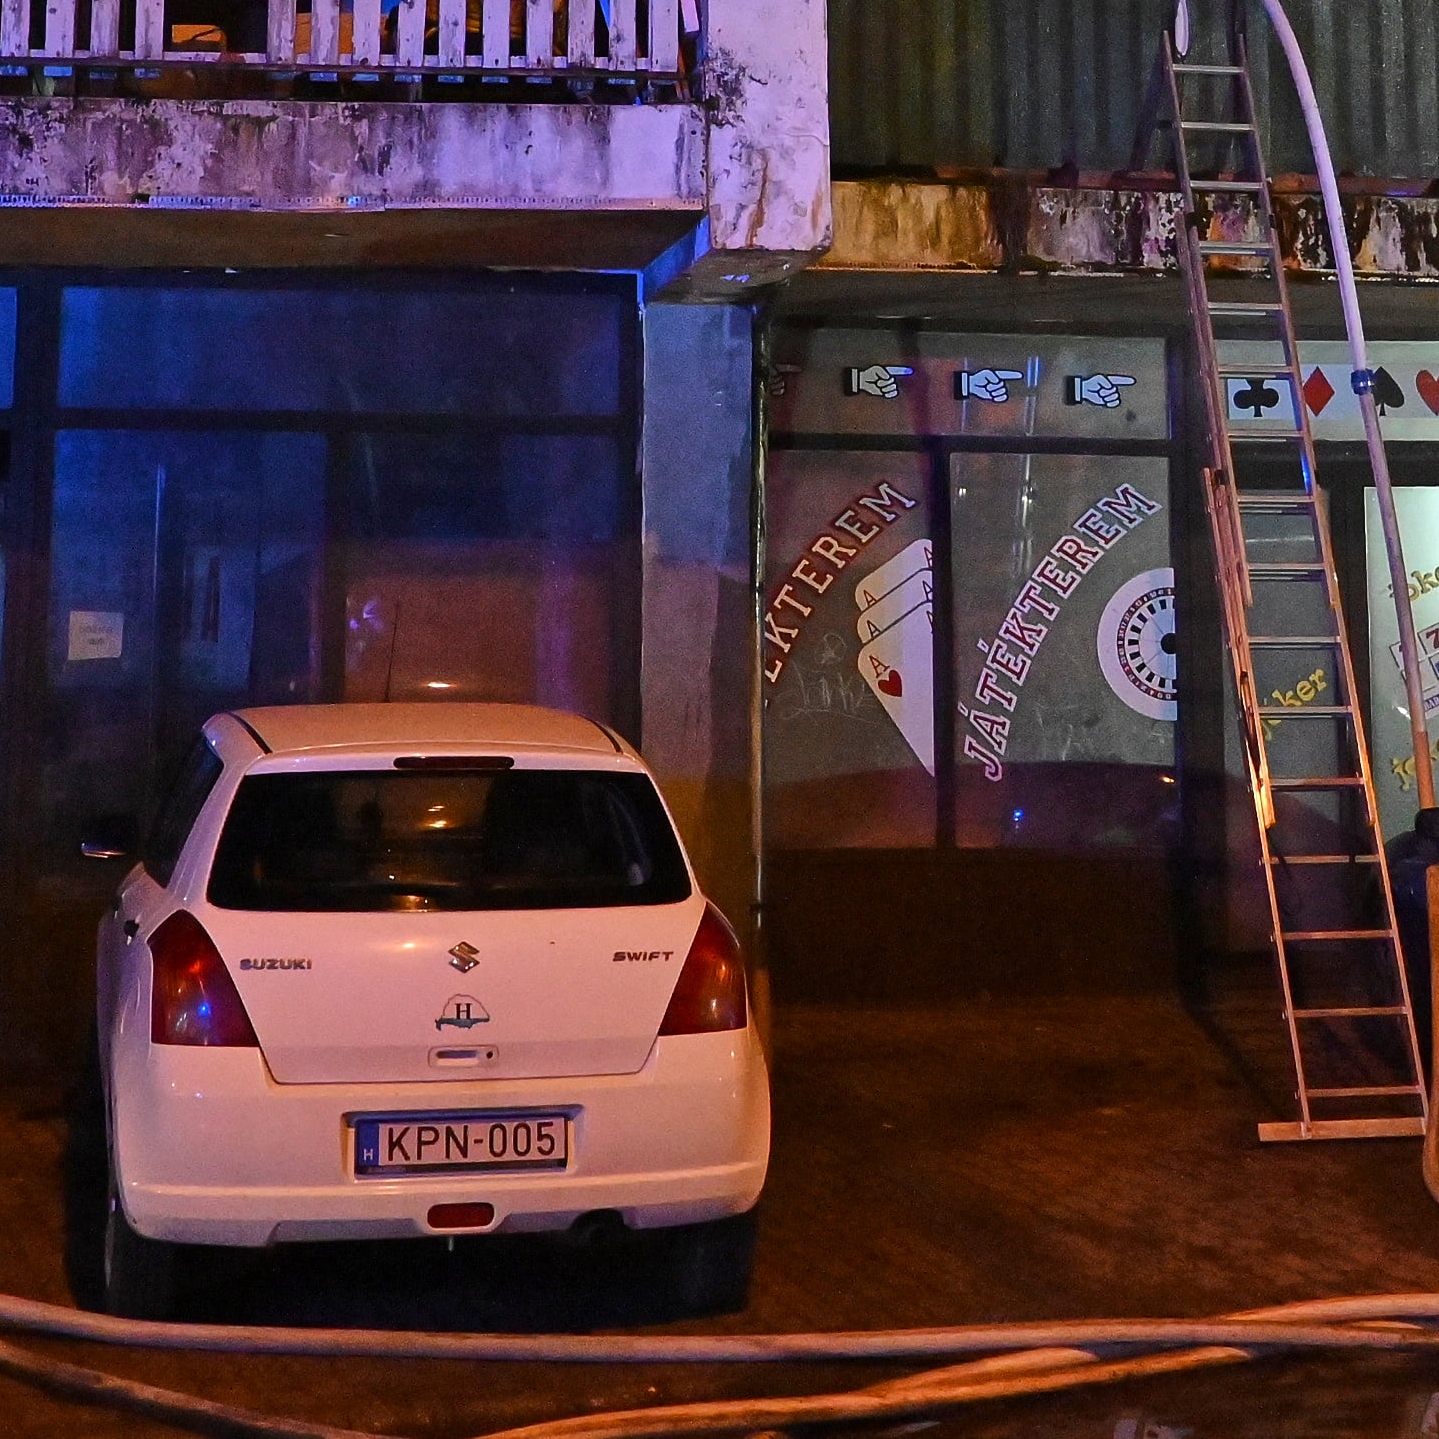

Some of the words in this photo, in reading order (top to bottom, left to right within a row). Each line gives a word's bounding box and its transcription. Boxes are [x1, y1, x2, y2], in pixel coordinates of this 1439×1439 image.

[957, 483, 1163, 782] JÁTÉKTEREM
[869, 655, 890, 678] A
[240, 958, 312, 970] SUZUKI
[613, 951, 674, 962] SWIFT
[455, 1002, 472, 1020] H
[387, 1121, 556, 1162] KPN-005
[363, 1148, 375, 1162] H
